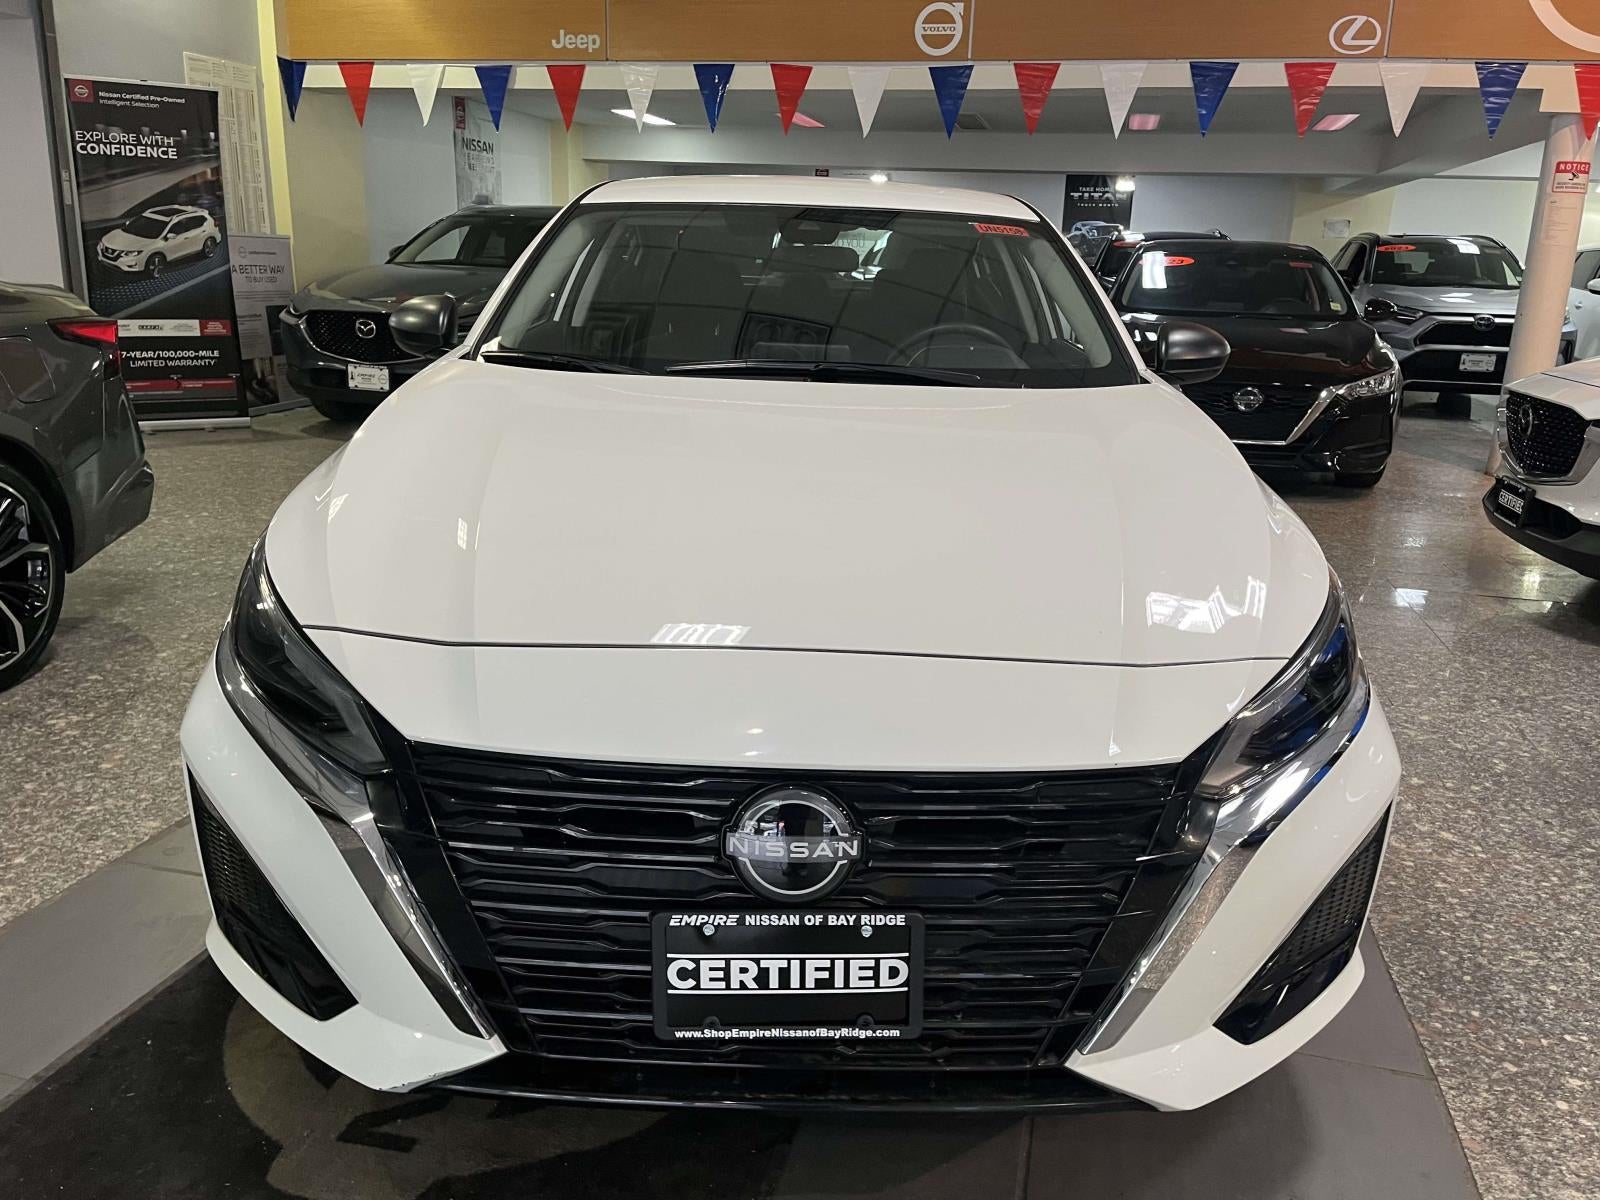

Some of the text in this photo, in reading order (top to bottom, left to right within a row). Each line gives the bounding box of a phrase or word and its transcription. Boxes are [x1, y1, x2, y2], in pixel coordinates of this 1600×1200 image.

[552, 29, 600, 53] Jeep
[98, 91, 185, 104] Nissan Certified Pre-Owned
[75, 130, 174, 147] EXPLORE WITH
[76, 142, 178, 159] CONFIDENCE
[462, 137, 494, 155] NISSAN
[1559, 163, 1589, 172] NOTICE
[1070, 192, 1128, 200] TITAN
[239, 264, 268, 275] BETTER
[268, 265, 286, 274] WAY
[121, 350, 219, 359] 7-YEAR/100,000-MILE
[729, 837, 858, 858] NISSAN
[669, 914, 906, 926] EMPIRE NISSAN OF BAY RIDGE
[667, 959, 909, 989] CERTIFIED
[674, 1028, 900, 1039] www.ShopEmpireNissanofBayRidge.com
